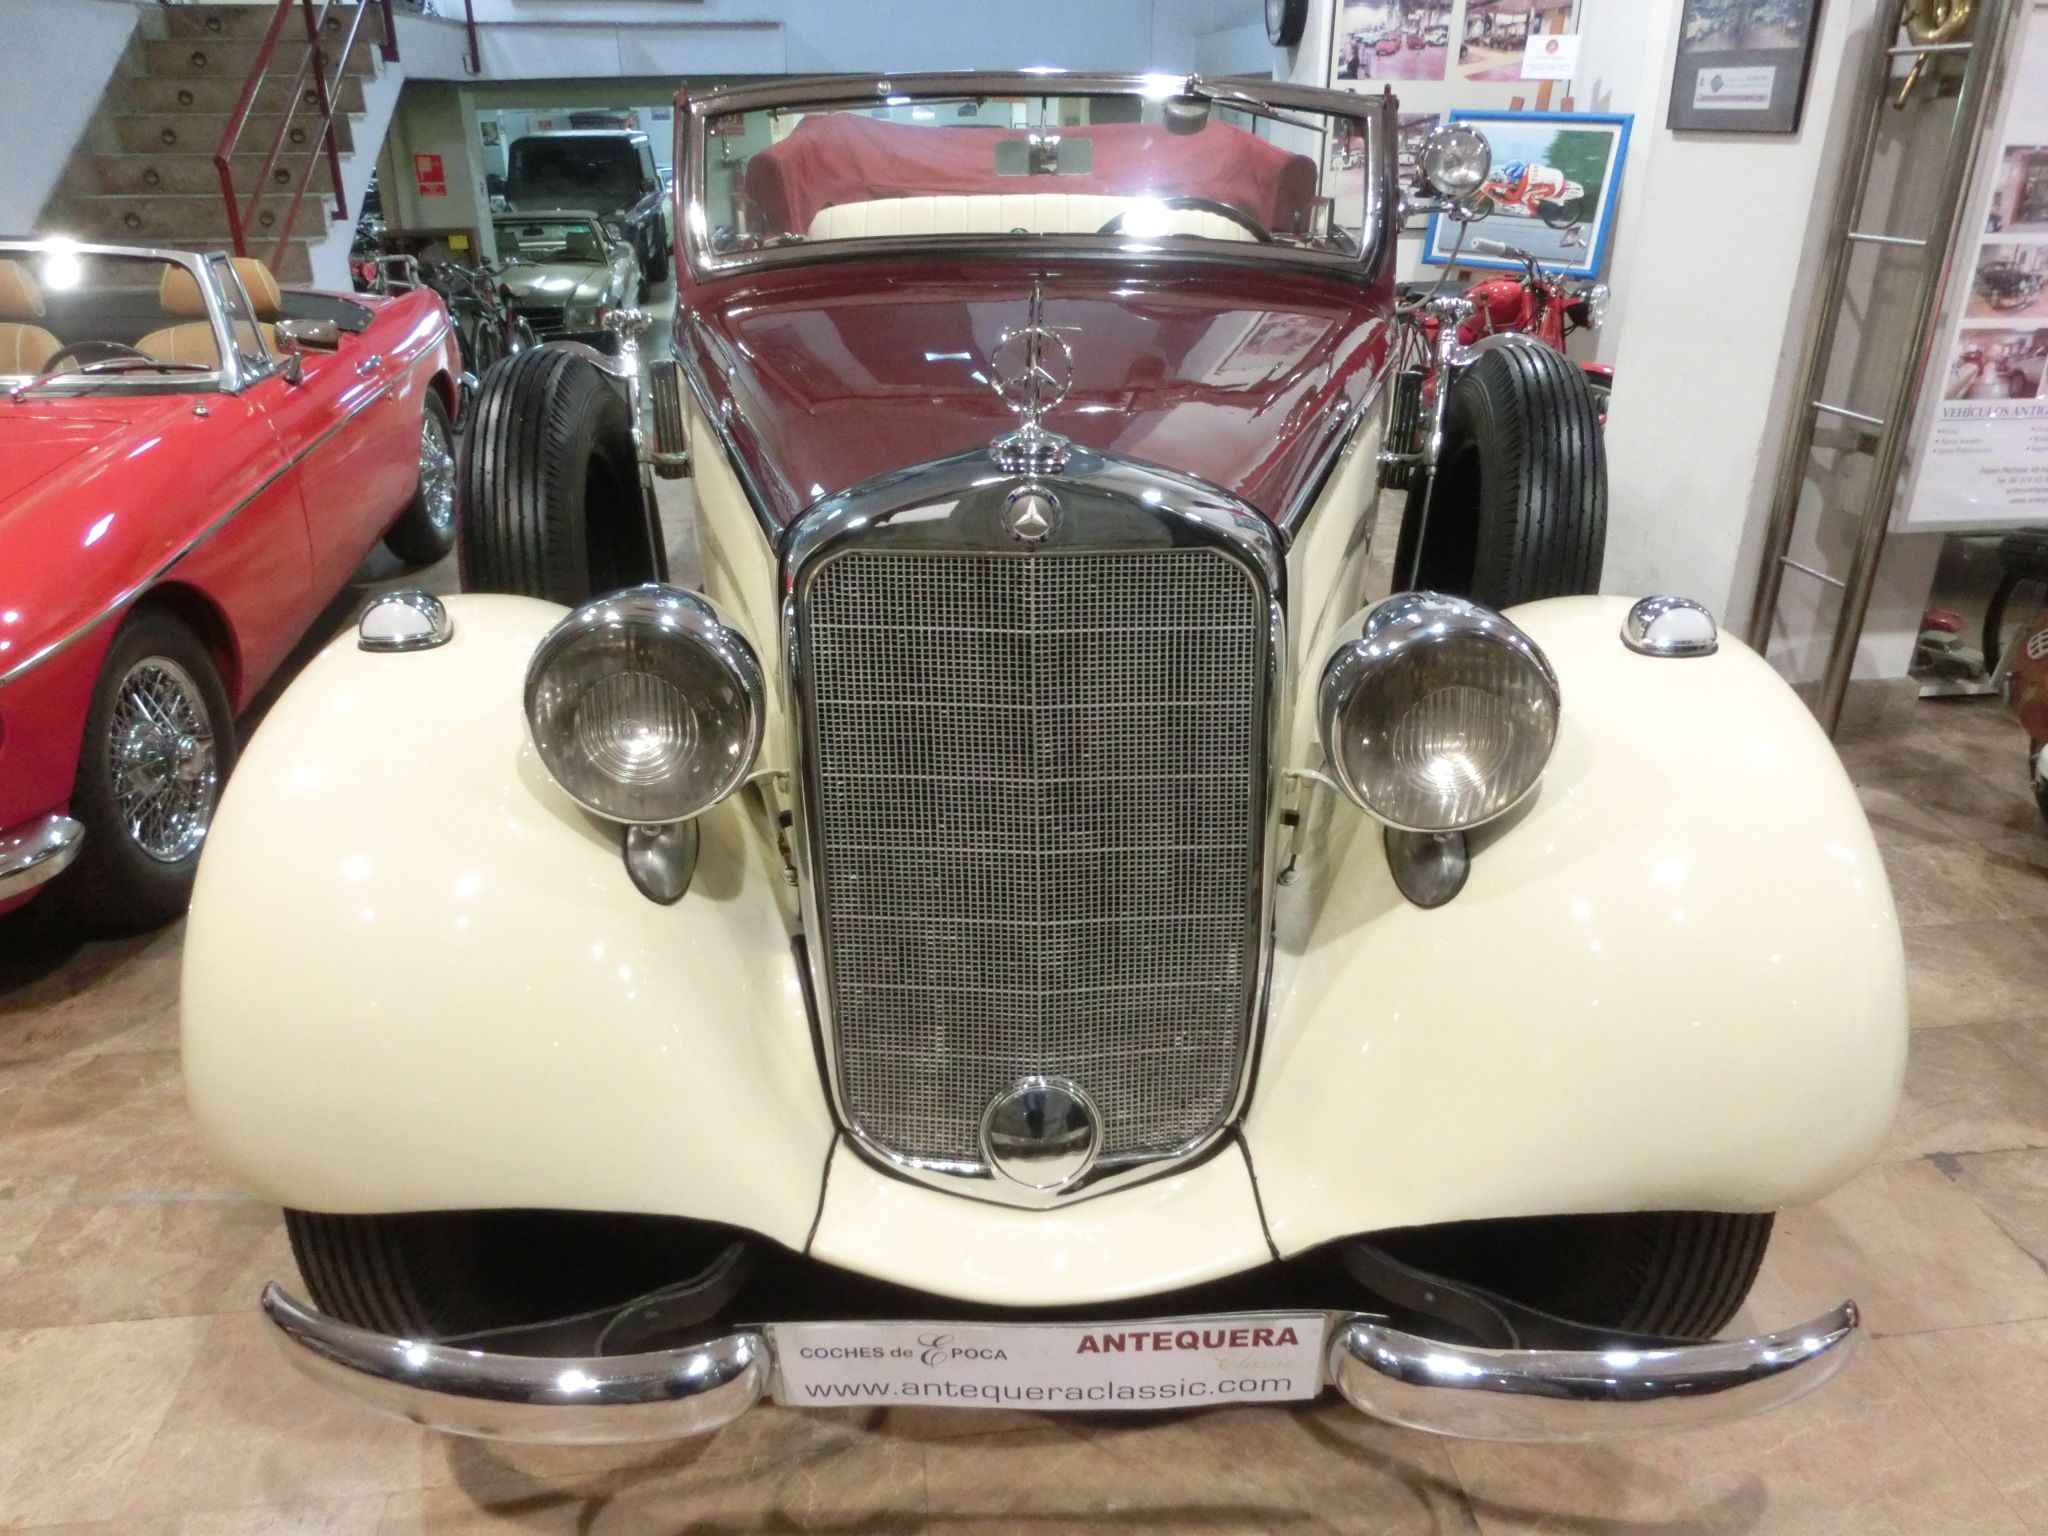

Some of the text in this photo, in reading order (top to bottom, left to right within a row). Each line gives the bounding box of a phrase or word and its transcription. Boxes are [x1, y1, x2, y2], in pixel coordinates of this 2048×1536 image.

[800, 1347, 885, 1359] COCHES
[890, 1346, 913, 1358] de
[1076, 1326, 1299, 1354] ANTEQUERA
[805, 1377, 1292, 1404] www.antequeraclassic.com
